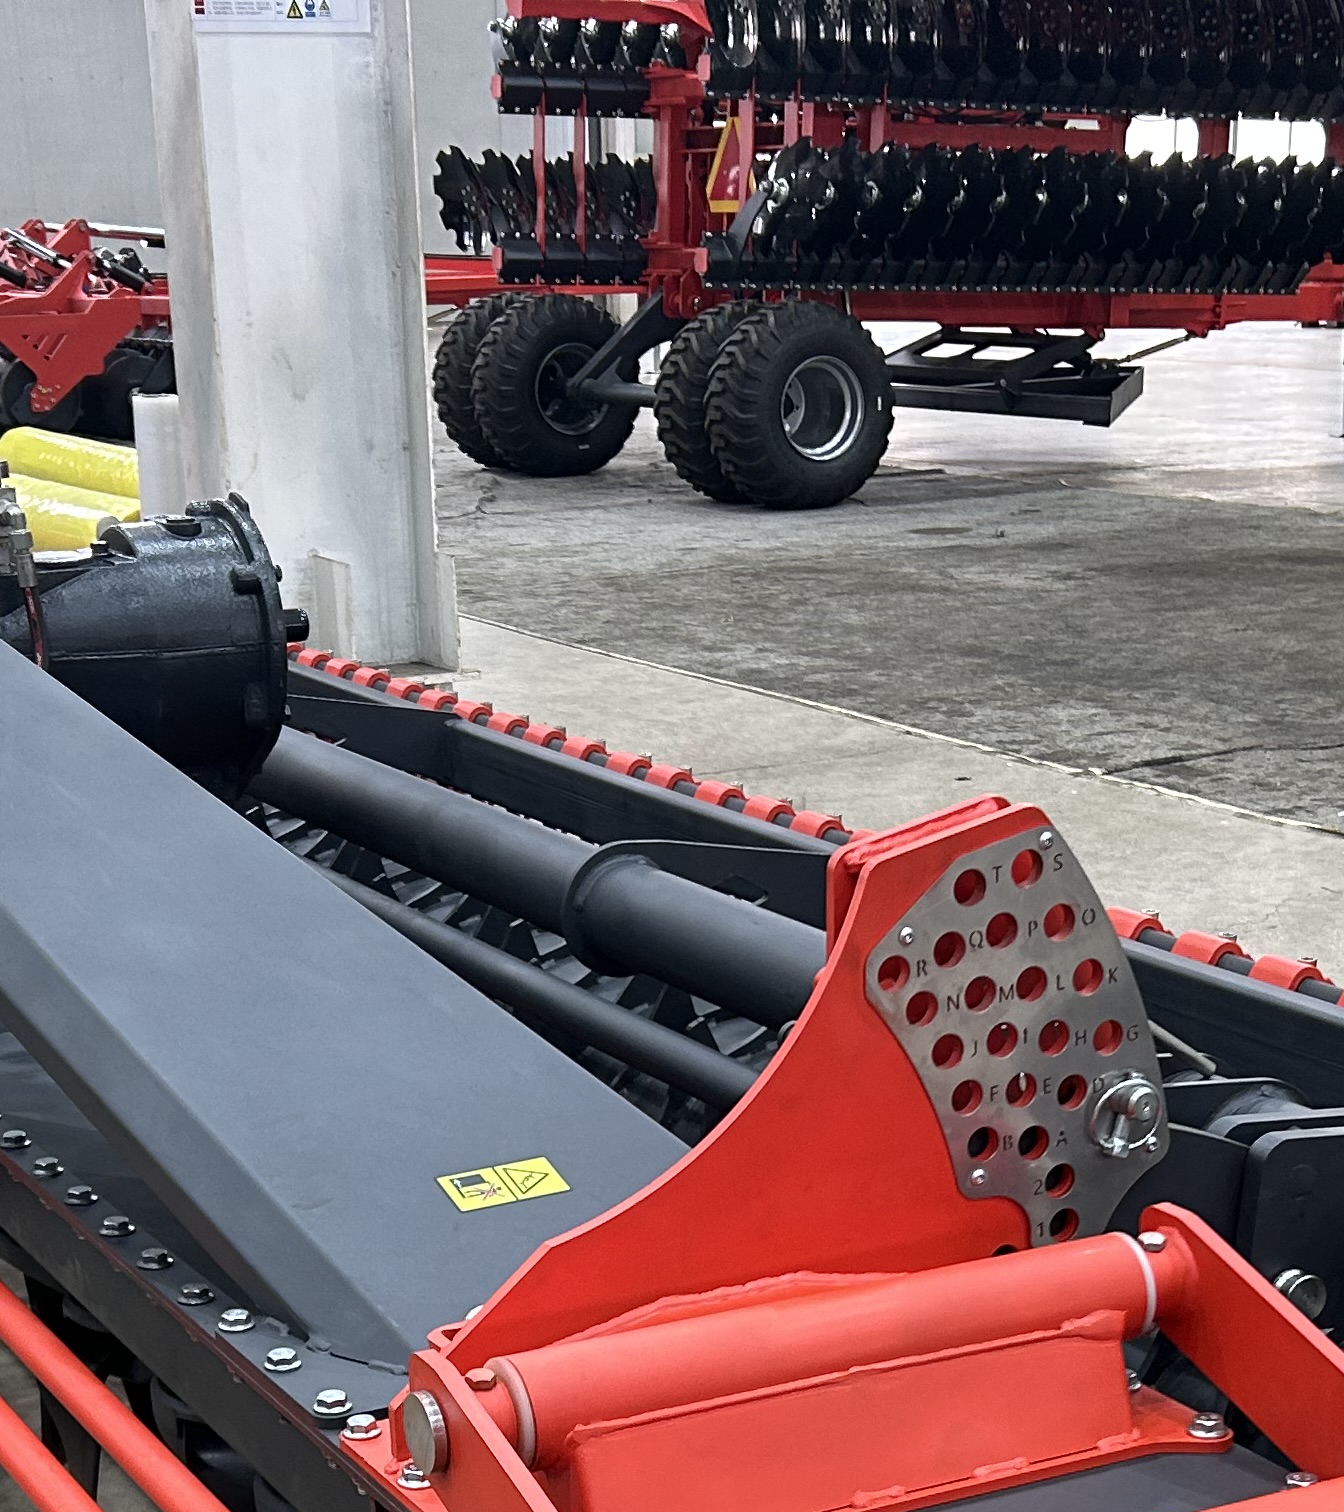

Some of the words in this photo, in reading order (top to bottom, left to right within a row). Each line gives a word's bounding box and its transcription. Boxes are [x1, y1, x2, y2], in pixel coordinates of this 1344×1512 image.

[1053, 853, 1063, 872] S
[992, 865, 1003, 883] T
[1028, 920, 1038, 937] P
[916, 959, 927, 977] R
[1108, 966, 1119, 984] K
[1056, 974, 1065, 991] L
[998, 983, 1015, 1003] M
[946, 993, 961, 1012] N
[1074, 1029, 1088, 1047] H
[1126, 1024, 1140, 1042] G
[970, 1040, 978, 1058] J
[989, 1084, 999, 1102] F
[1043, 1077, 1053, 1095] E
[1092, 1077, 1105, 1094] D
[1003, 1135, 1013, 1152] B
[1056, 1131, 1068, 1148] A
[1033, 1179, 1043, 1196] 2
[1037, 1222, 1044, 1238] 1
